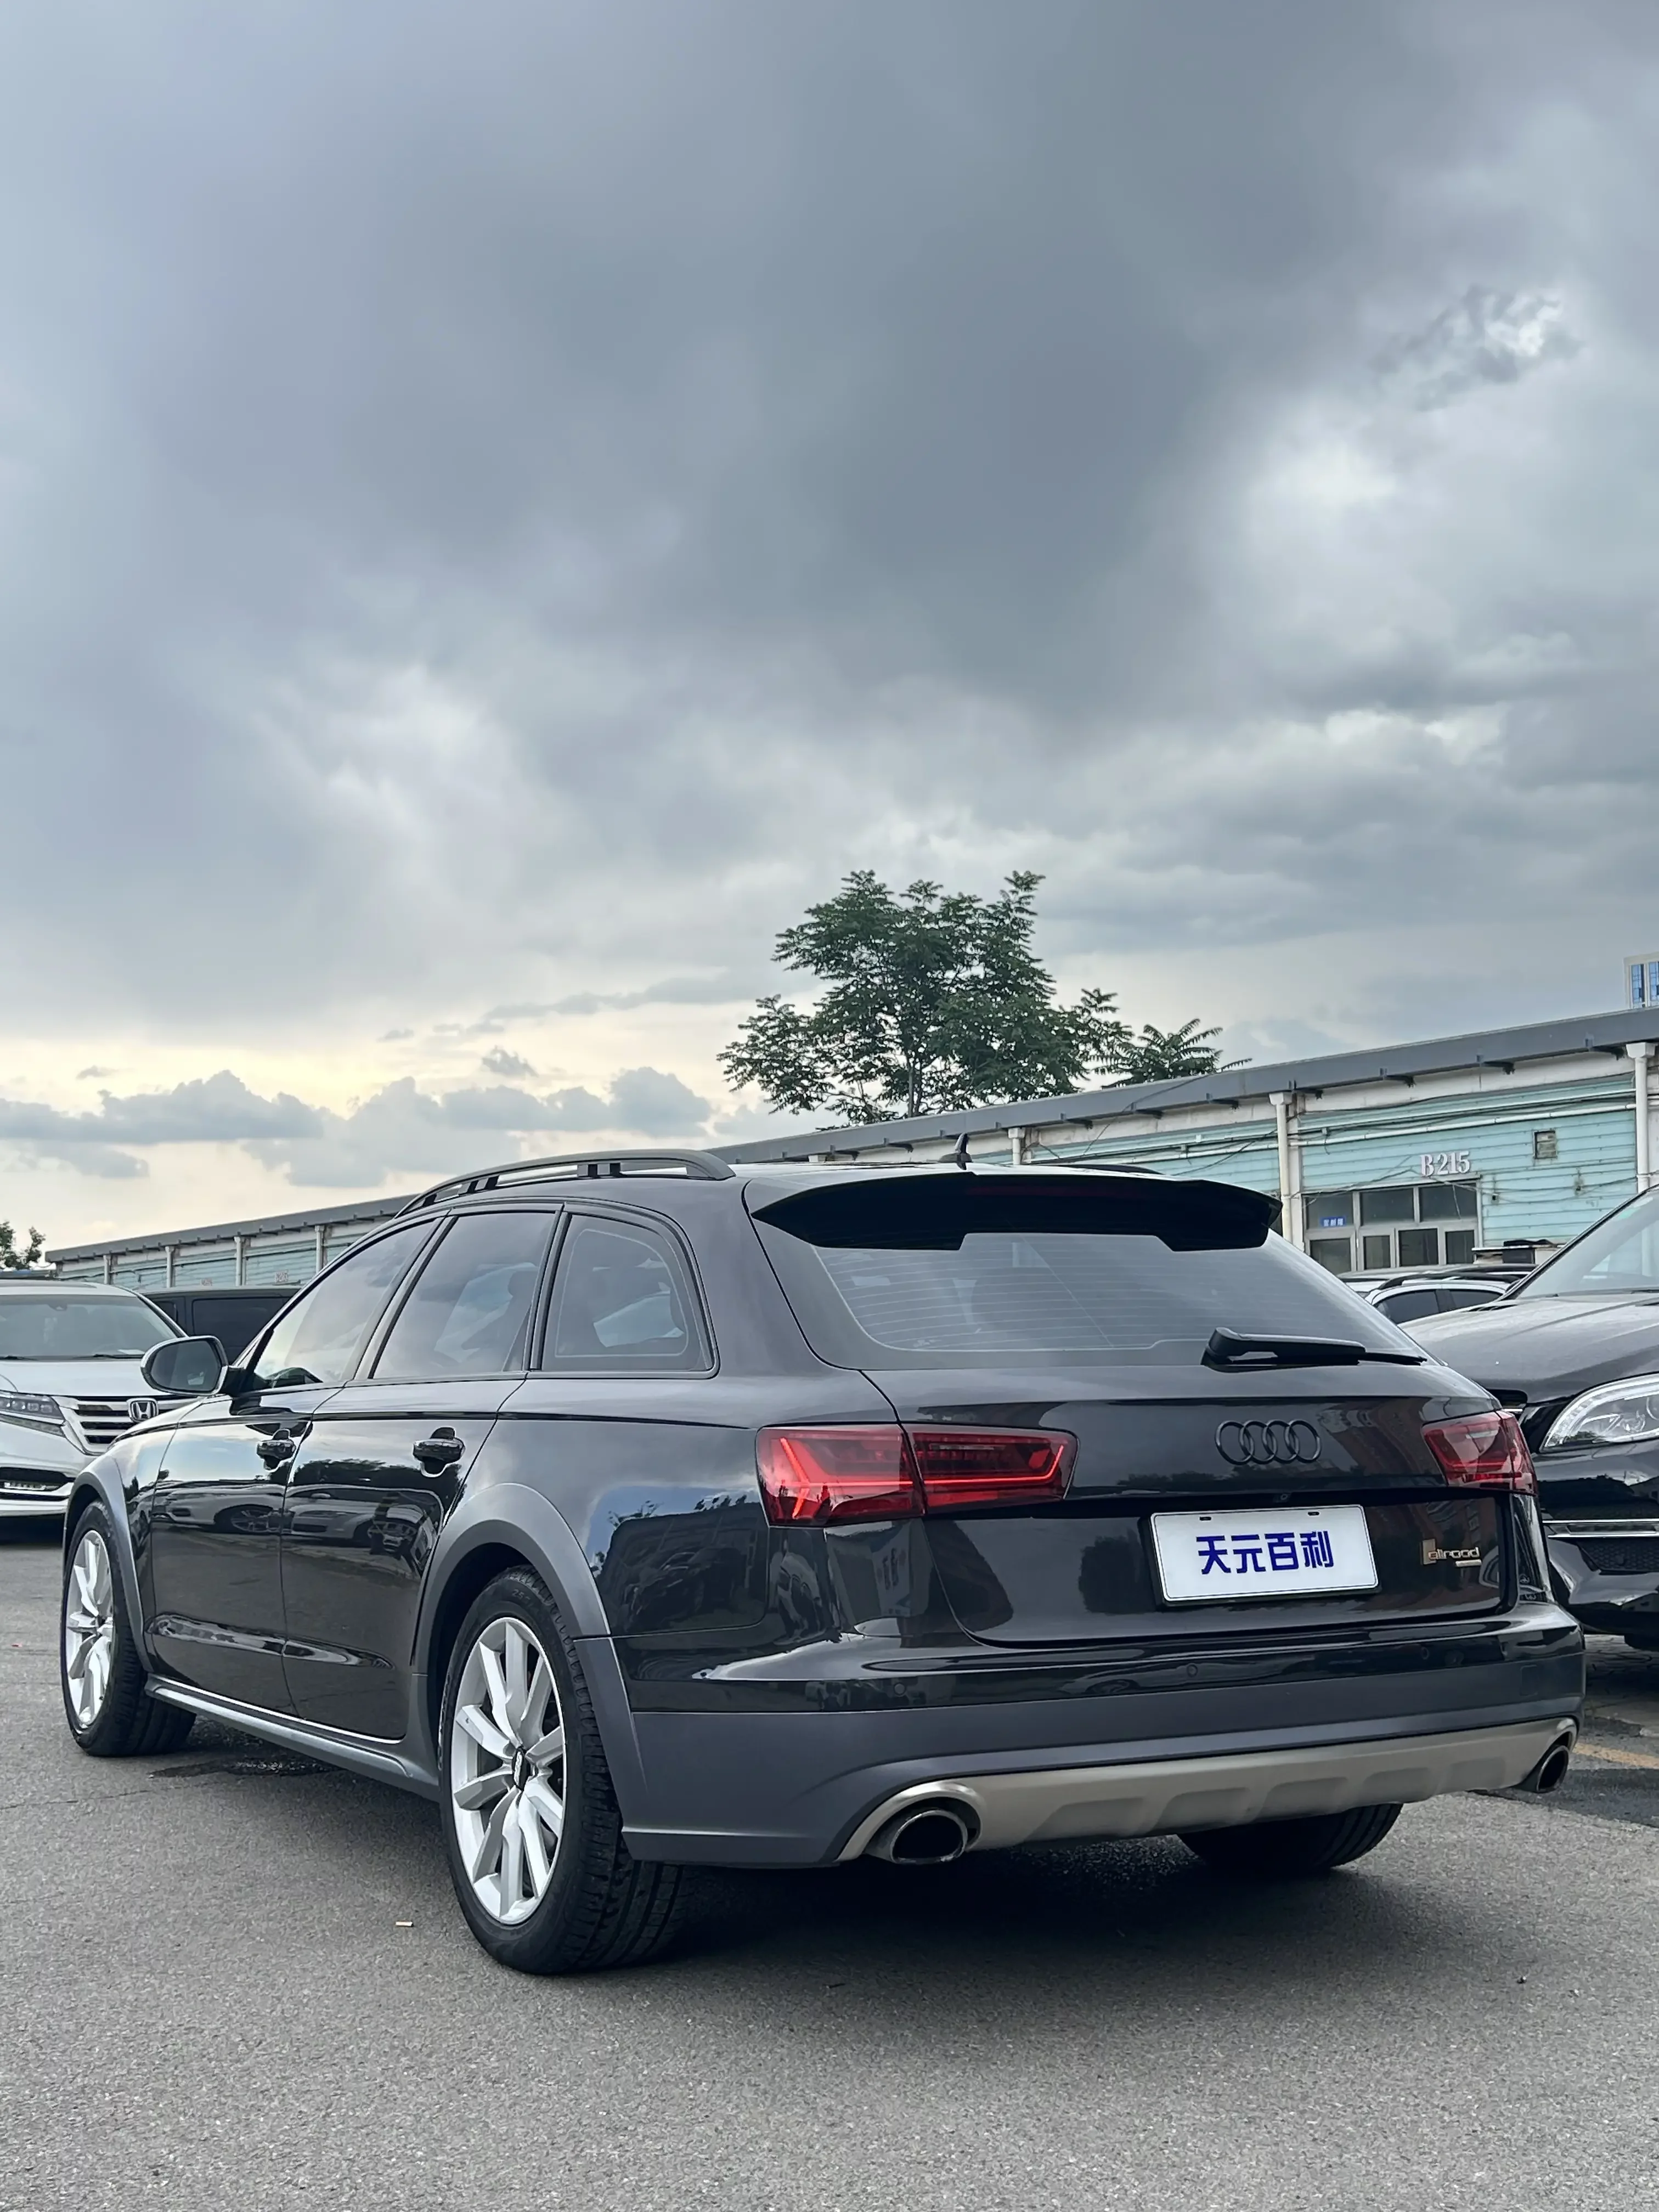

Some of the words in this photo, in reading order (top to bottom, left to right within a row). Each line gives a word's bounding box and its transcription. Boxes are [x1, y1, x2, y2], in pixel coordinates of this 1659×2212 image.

[1420, 1150, 1470, 1177] B215
[1196, 1531, 1334, 1575] 天元百利
